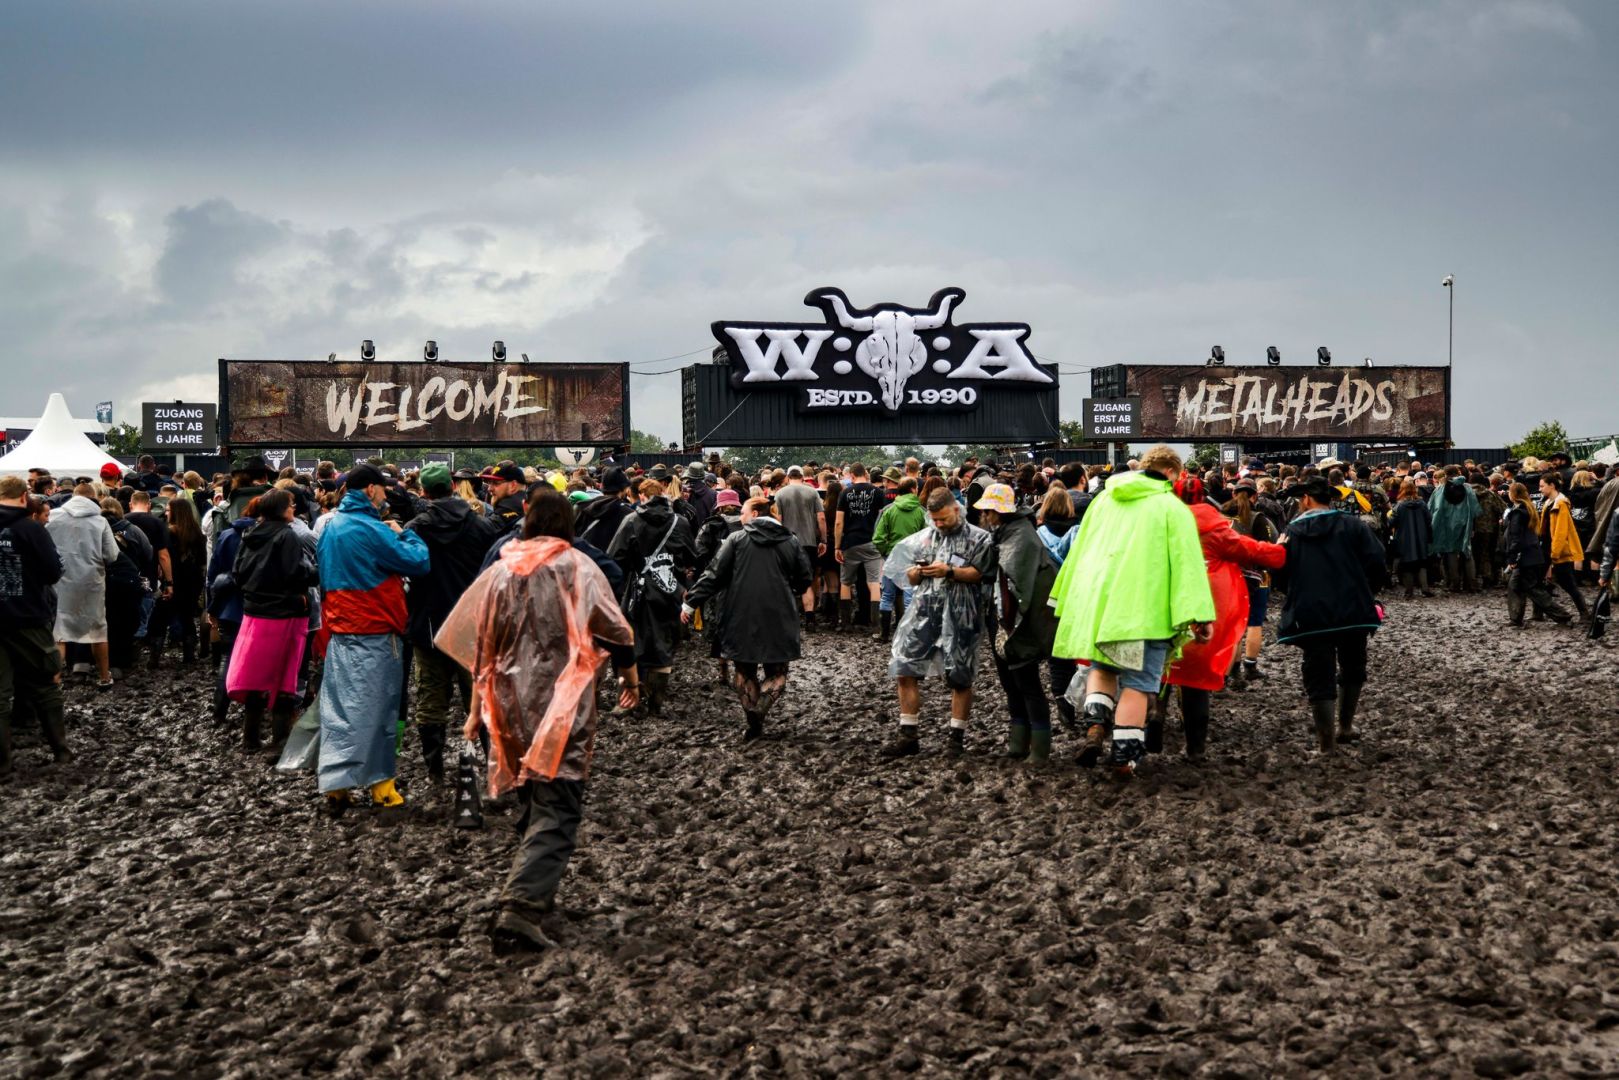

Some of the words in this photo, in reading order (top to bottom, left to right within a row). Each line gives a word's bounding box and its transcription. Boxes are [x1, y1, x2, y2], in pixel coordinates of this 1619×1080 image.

[806, 388, 878, 407] ESTD.
[907, 387, 977, 405] 1990
[326, 371, 549, 439] WELCOME
[1093, 403, 1132, 412] ZUGANG
[1175, 371, 1396, 435] METALHEADS
[154, 408, 204, 419] ZUGANG
[1094, 414, 1117, 423] ERST
[1118, 414, 1131, 423] AB
[155, 421, 184, 432] ERST
[187, 421, 203, 431] AB
[1094, 426, 1100, 434] 6
[1101, 426, 1131, 434] JAHRE
[156, 434, 163, 444] 6
[165, 434, 203, 444] JAHRE
